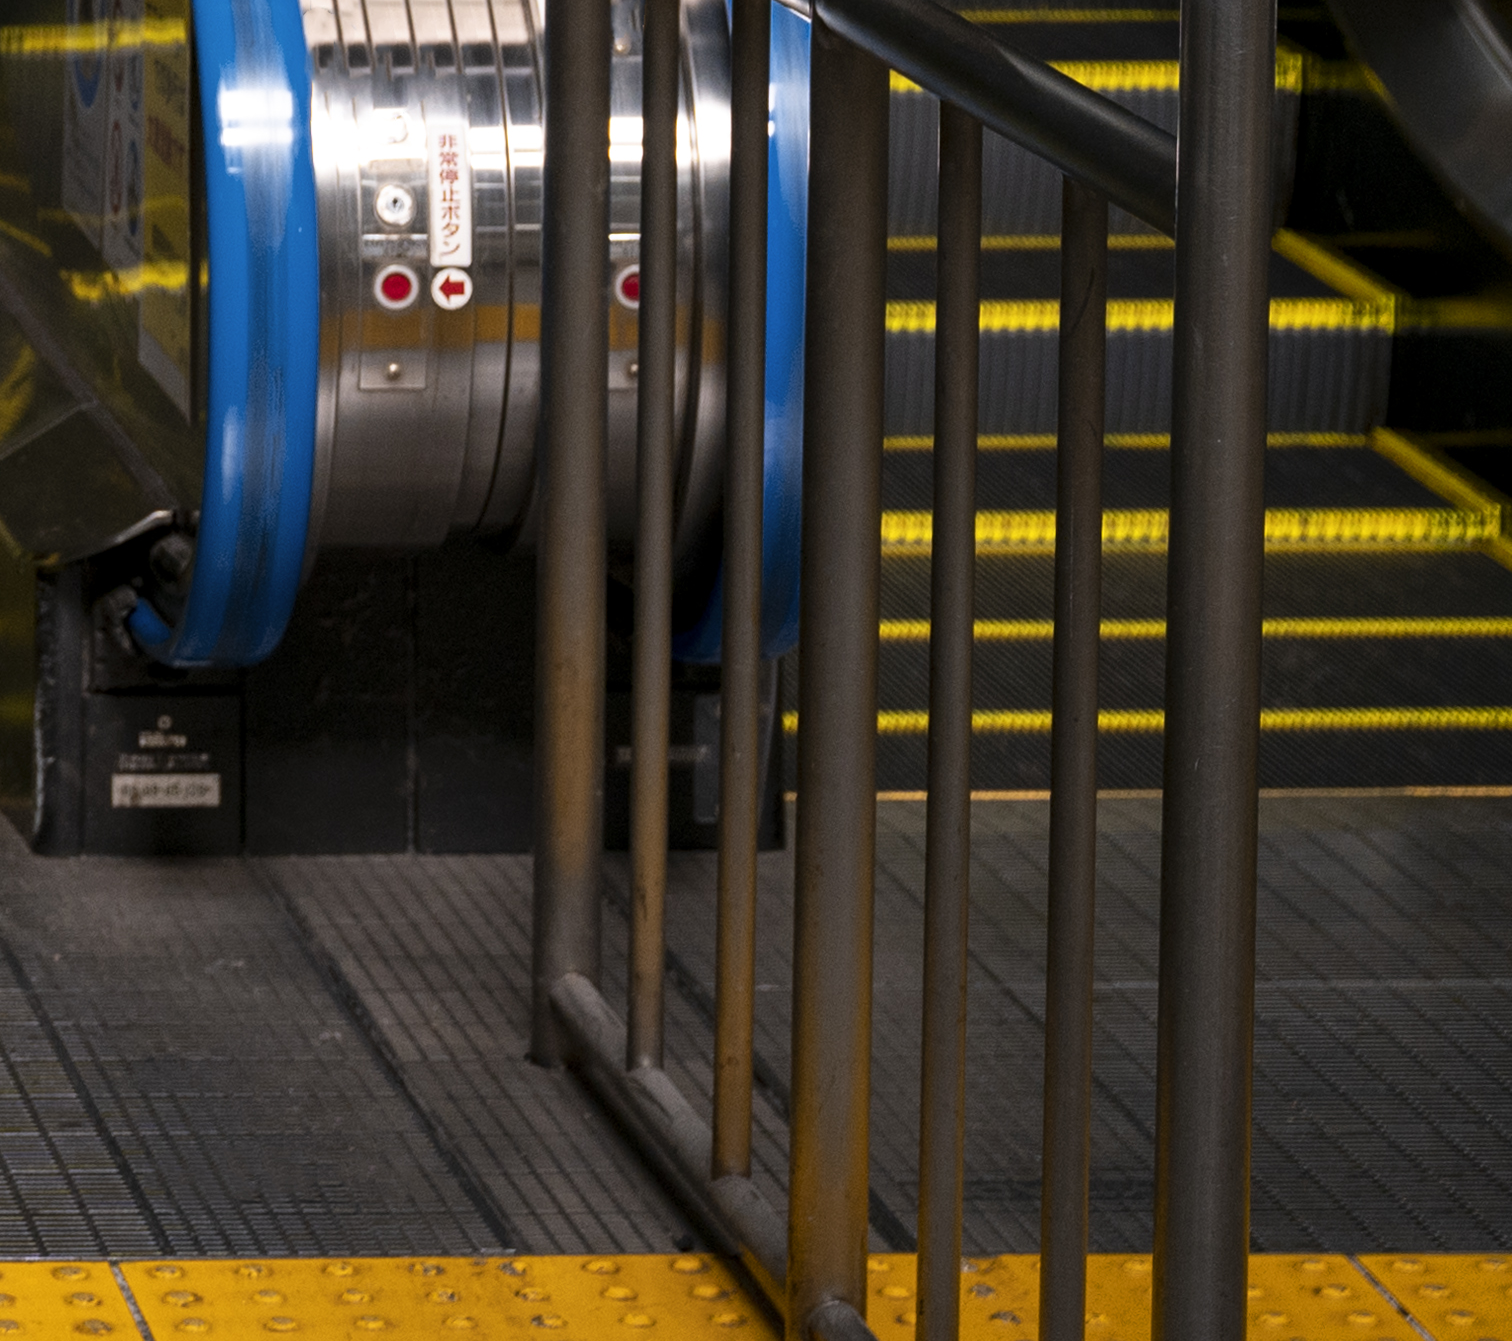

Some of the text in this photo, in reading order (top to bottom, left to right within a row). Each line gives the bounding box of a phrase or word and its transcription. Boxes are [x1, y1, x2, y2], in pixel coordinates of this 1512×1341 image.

[438, 134, 461, 257] 非常停止ボタン
